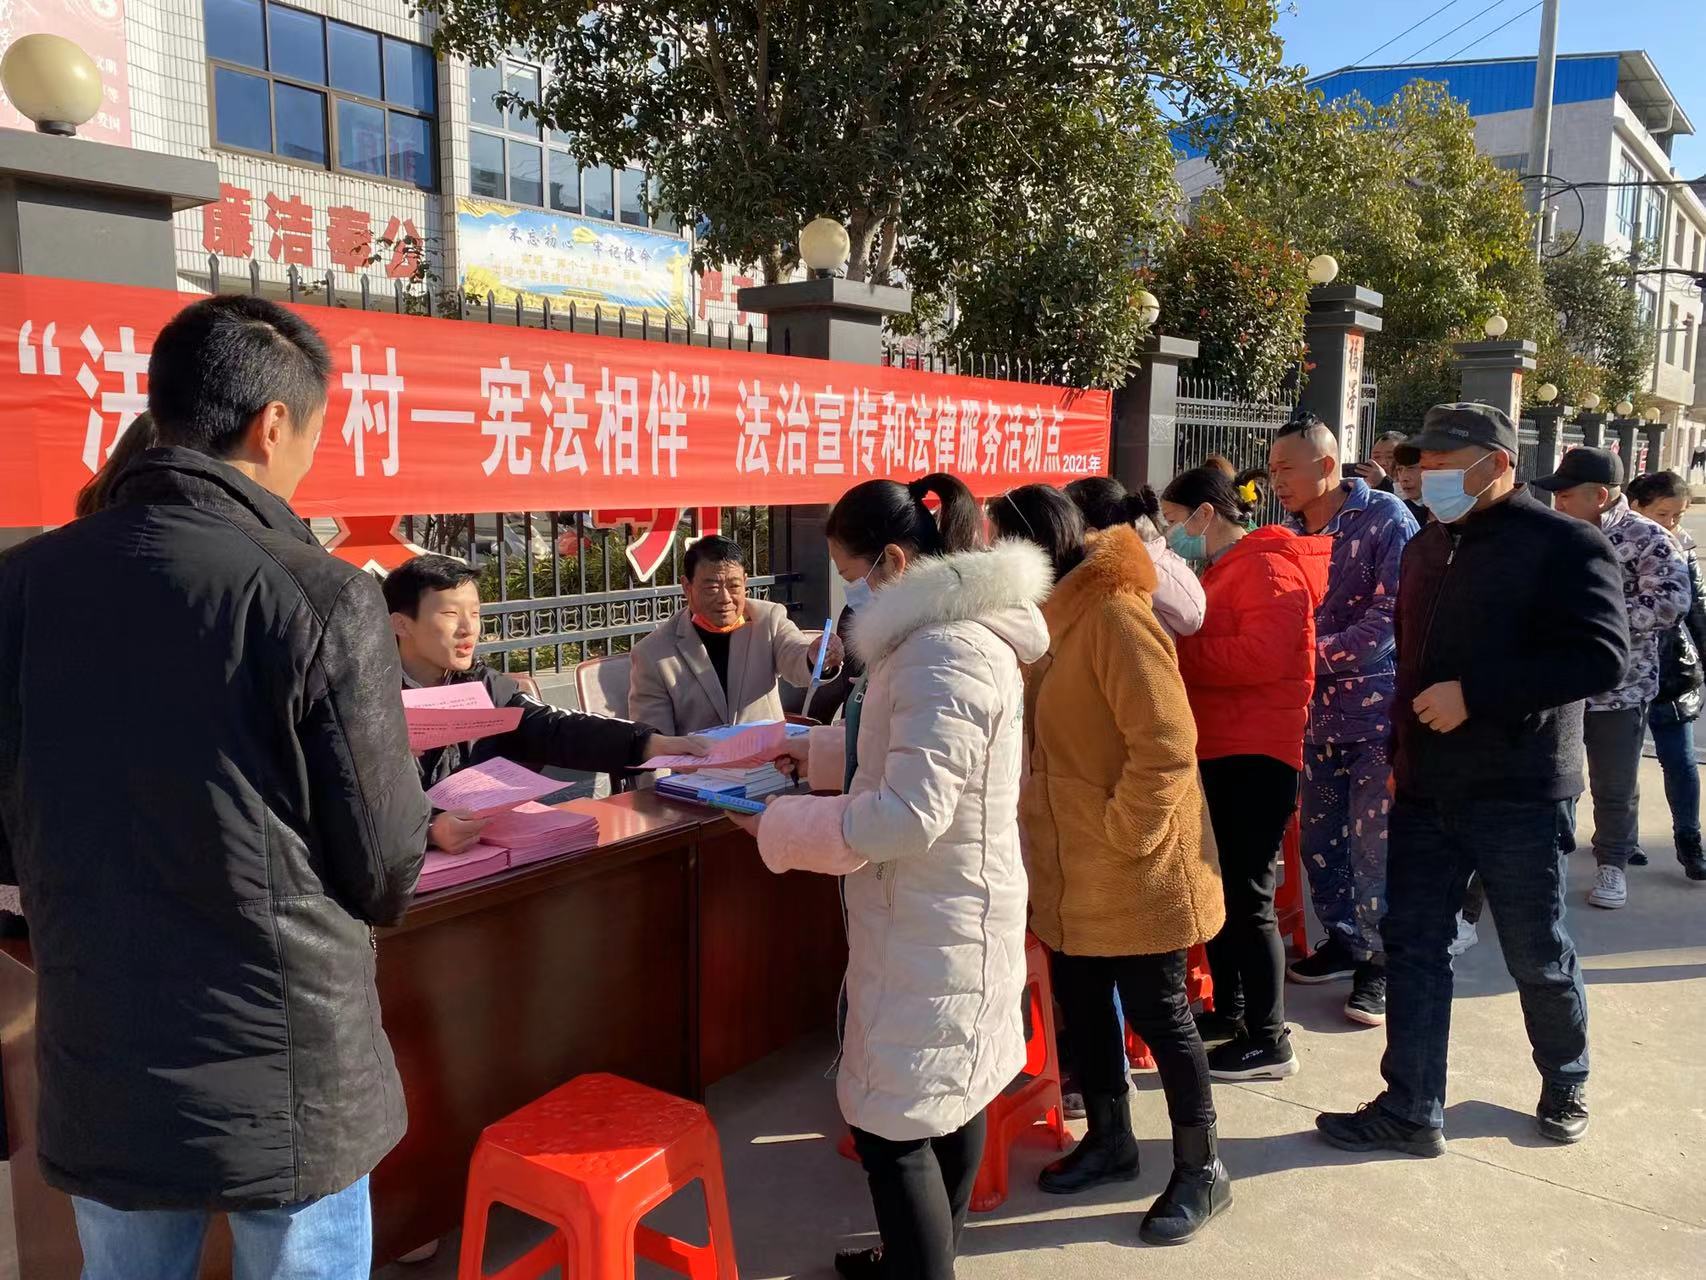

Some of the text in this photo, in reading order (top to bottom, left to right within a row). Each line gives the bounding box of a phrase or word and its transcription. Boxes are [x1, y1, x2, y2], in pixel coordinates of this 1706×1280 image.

[202, 182, 424, 280] 廉洁奉公
[508, 226, 575, 250] 不忘初心
[592, 239, 652, 271] 牢记使命
[735, 378, 1064, 476] 法治宣传和法律服务活动点
[1062, 454, 1102, 474] 2021年
